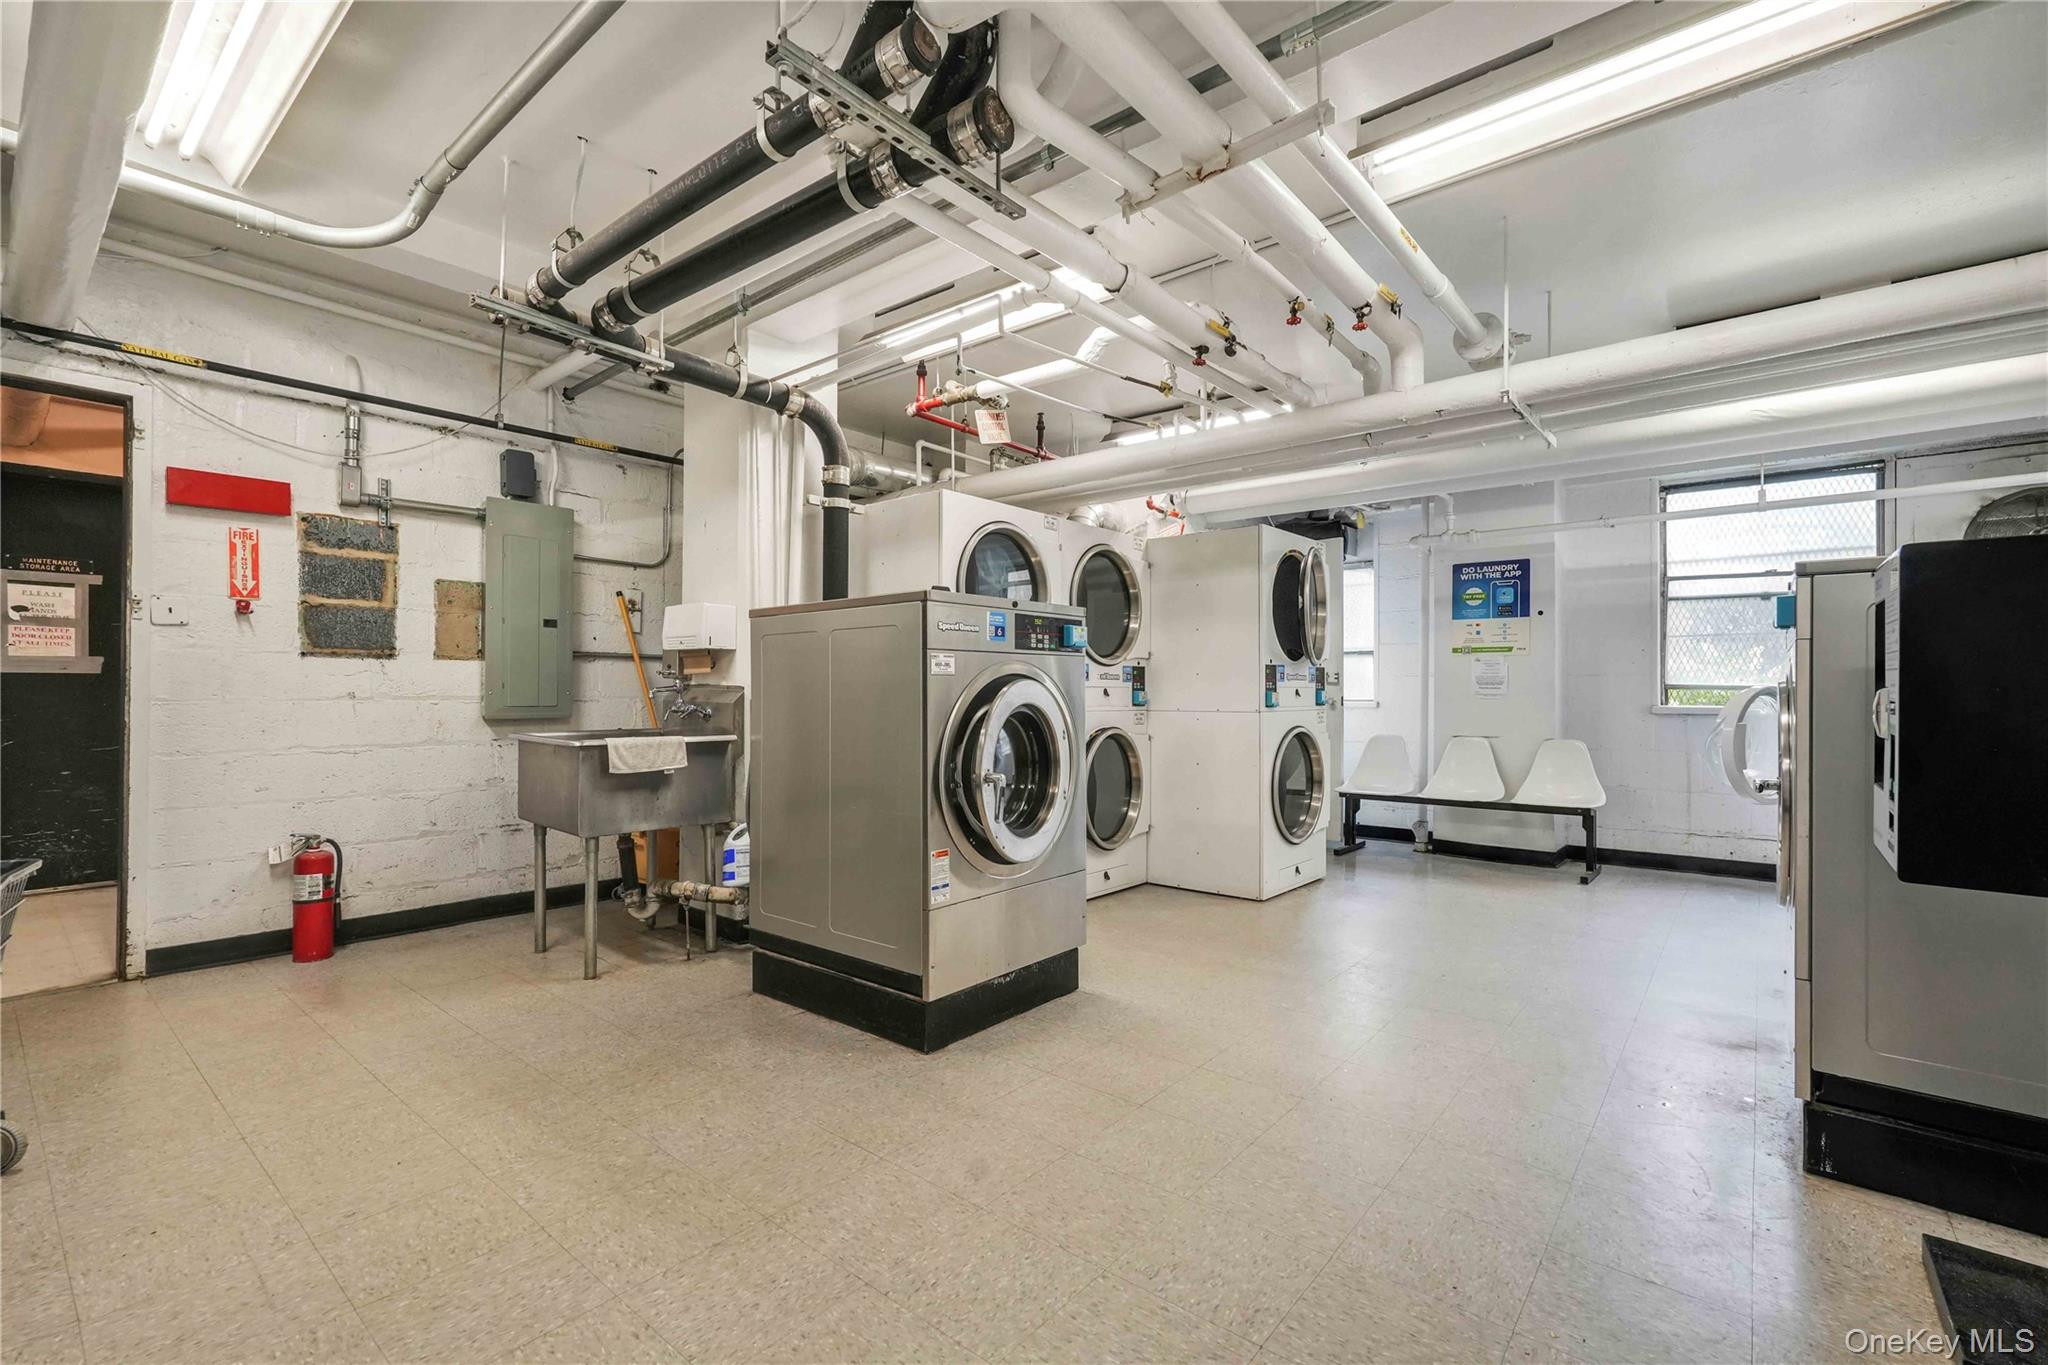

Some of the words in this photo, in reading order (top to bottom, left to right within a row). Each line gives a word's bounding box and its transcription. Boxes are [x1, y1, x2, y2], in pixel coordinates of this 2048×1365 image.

[664, 152, 729, 200] CHARLOTTE
[123, 344, 170, 357] NATURAL
[173, 353, 194, 365] GAS
[233, 530, 255, 541] FIRE
[22, 558, 78, 566] MAINTENANCE
[20, 563, 56, 571] STORAGE
[59, 565, 81, 573] AREA
[1477, 564, 1519, 572] LAUNDRY
[1460, 572, 1483, 580] WITH
[1484, 571, 1502, 579] THE
[30, 601, 55, 609] WASH
[937, 621, 960, 632] Speed
[959, 622, 980, 632] Queen
[38, 633, 72, 641] CLOSED
